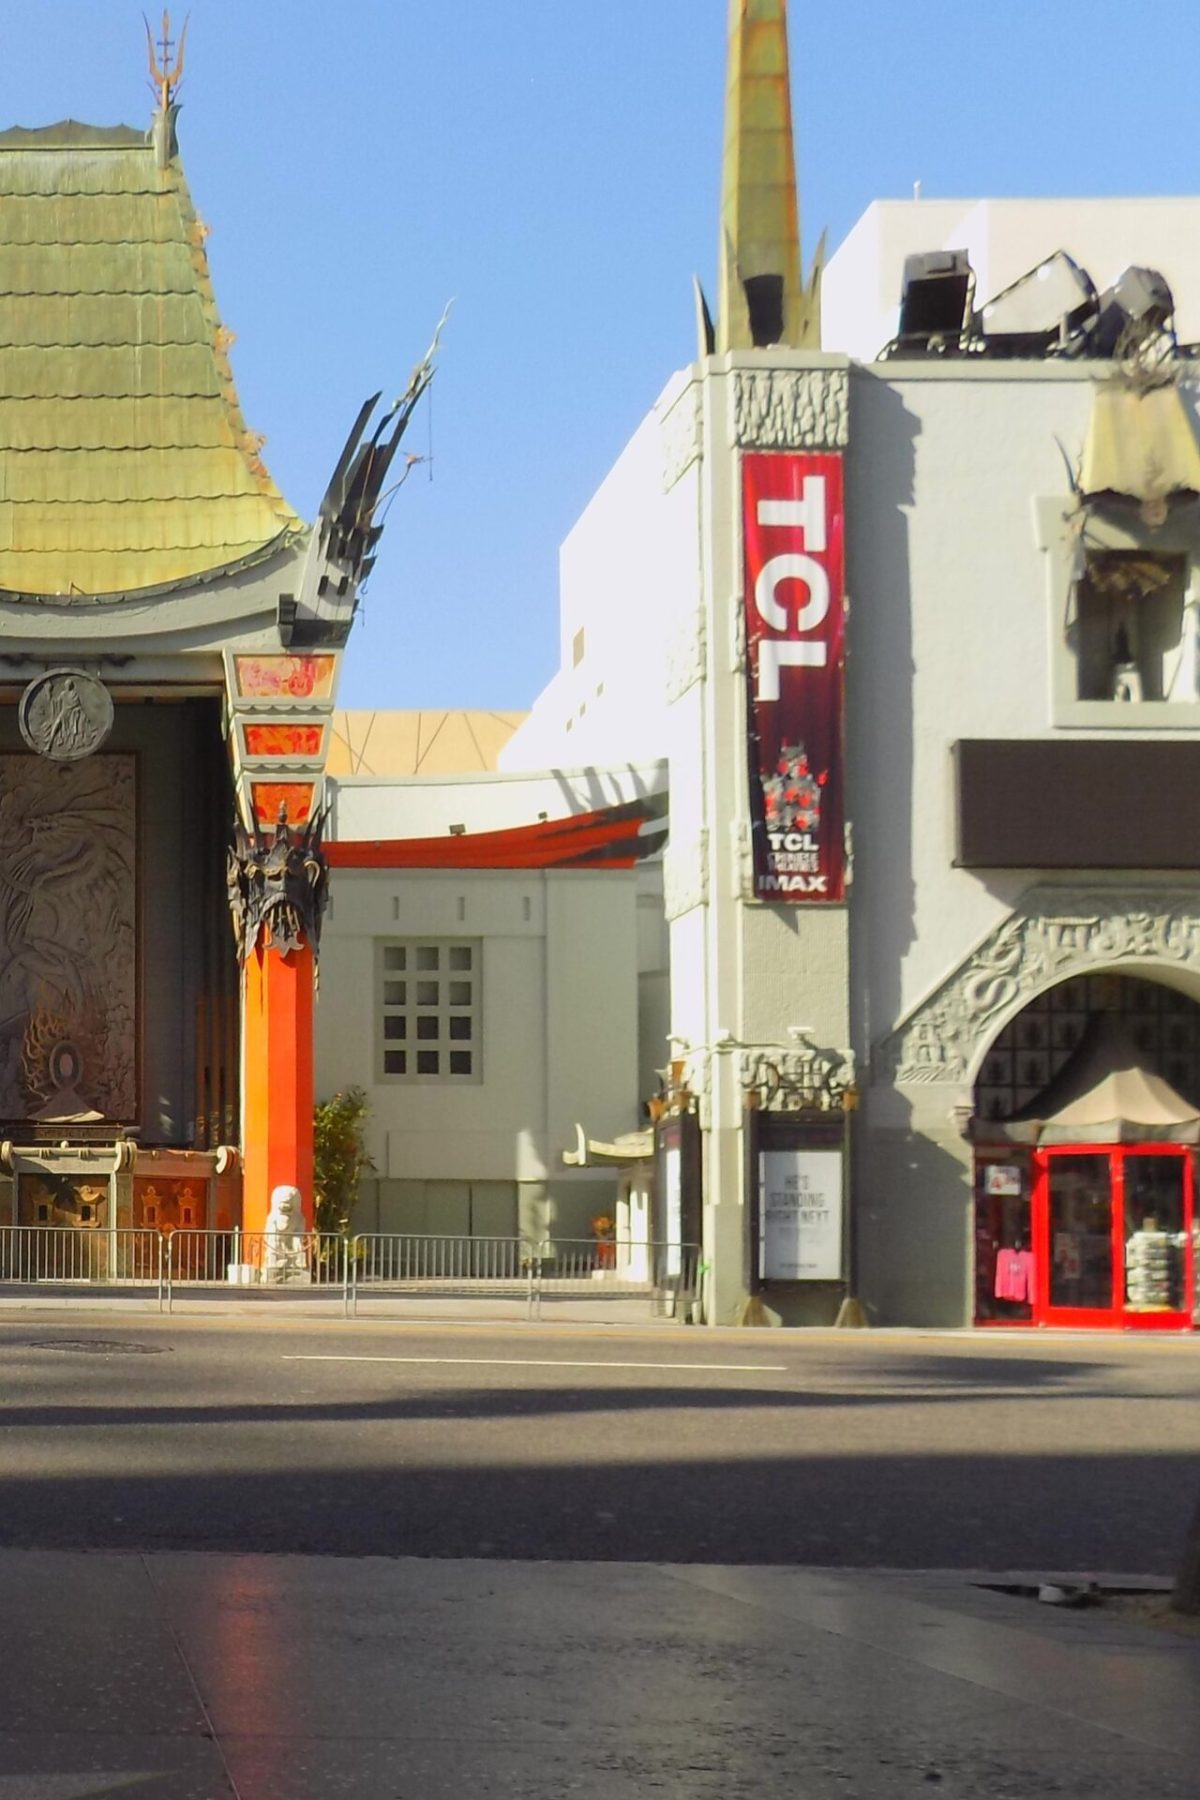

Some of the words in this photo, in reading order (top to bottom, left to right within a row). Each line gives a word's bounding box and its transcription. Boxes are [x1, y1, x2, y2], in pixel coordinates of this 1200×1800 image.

[755, 475, 829, 701] TCL
[767, 833, 820, 851] TCL
[759, 875, 828, 892] IMAX
